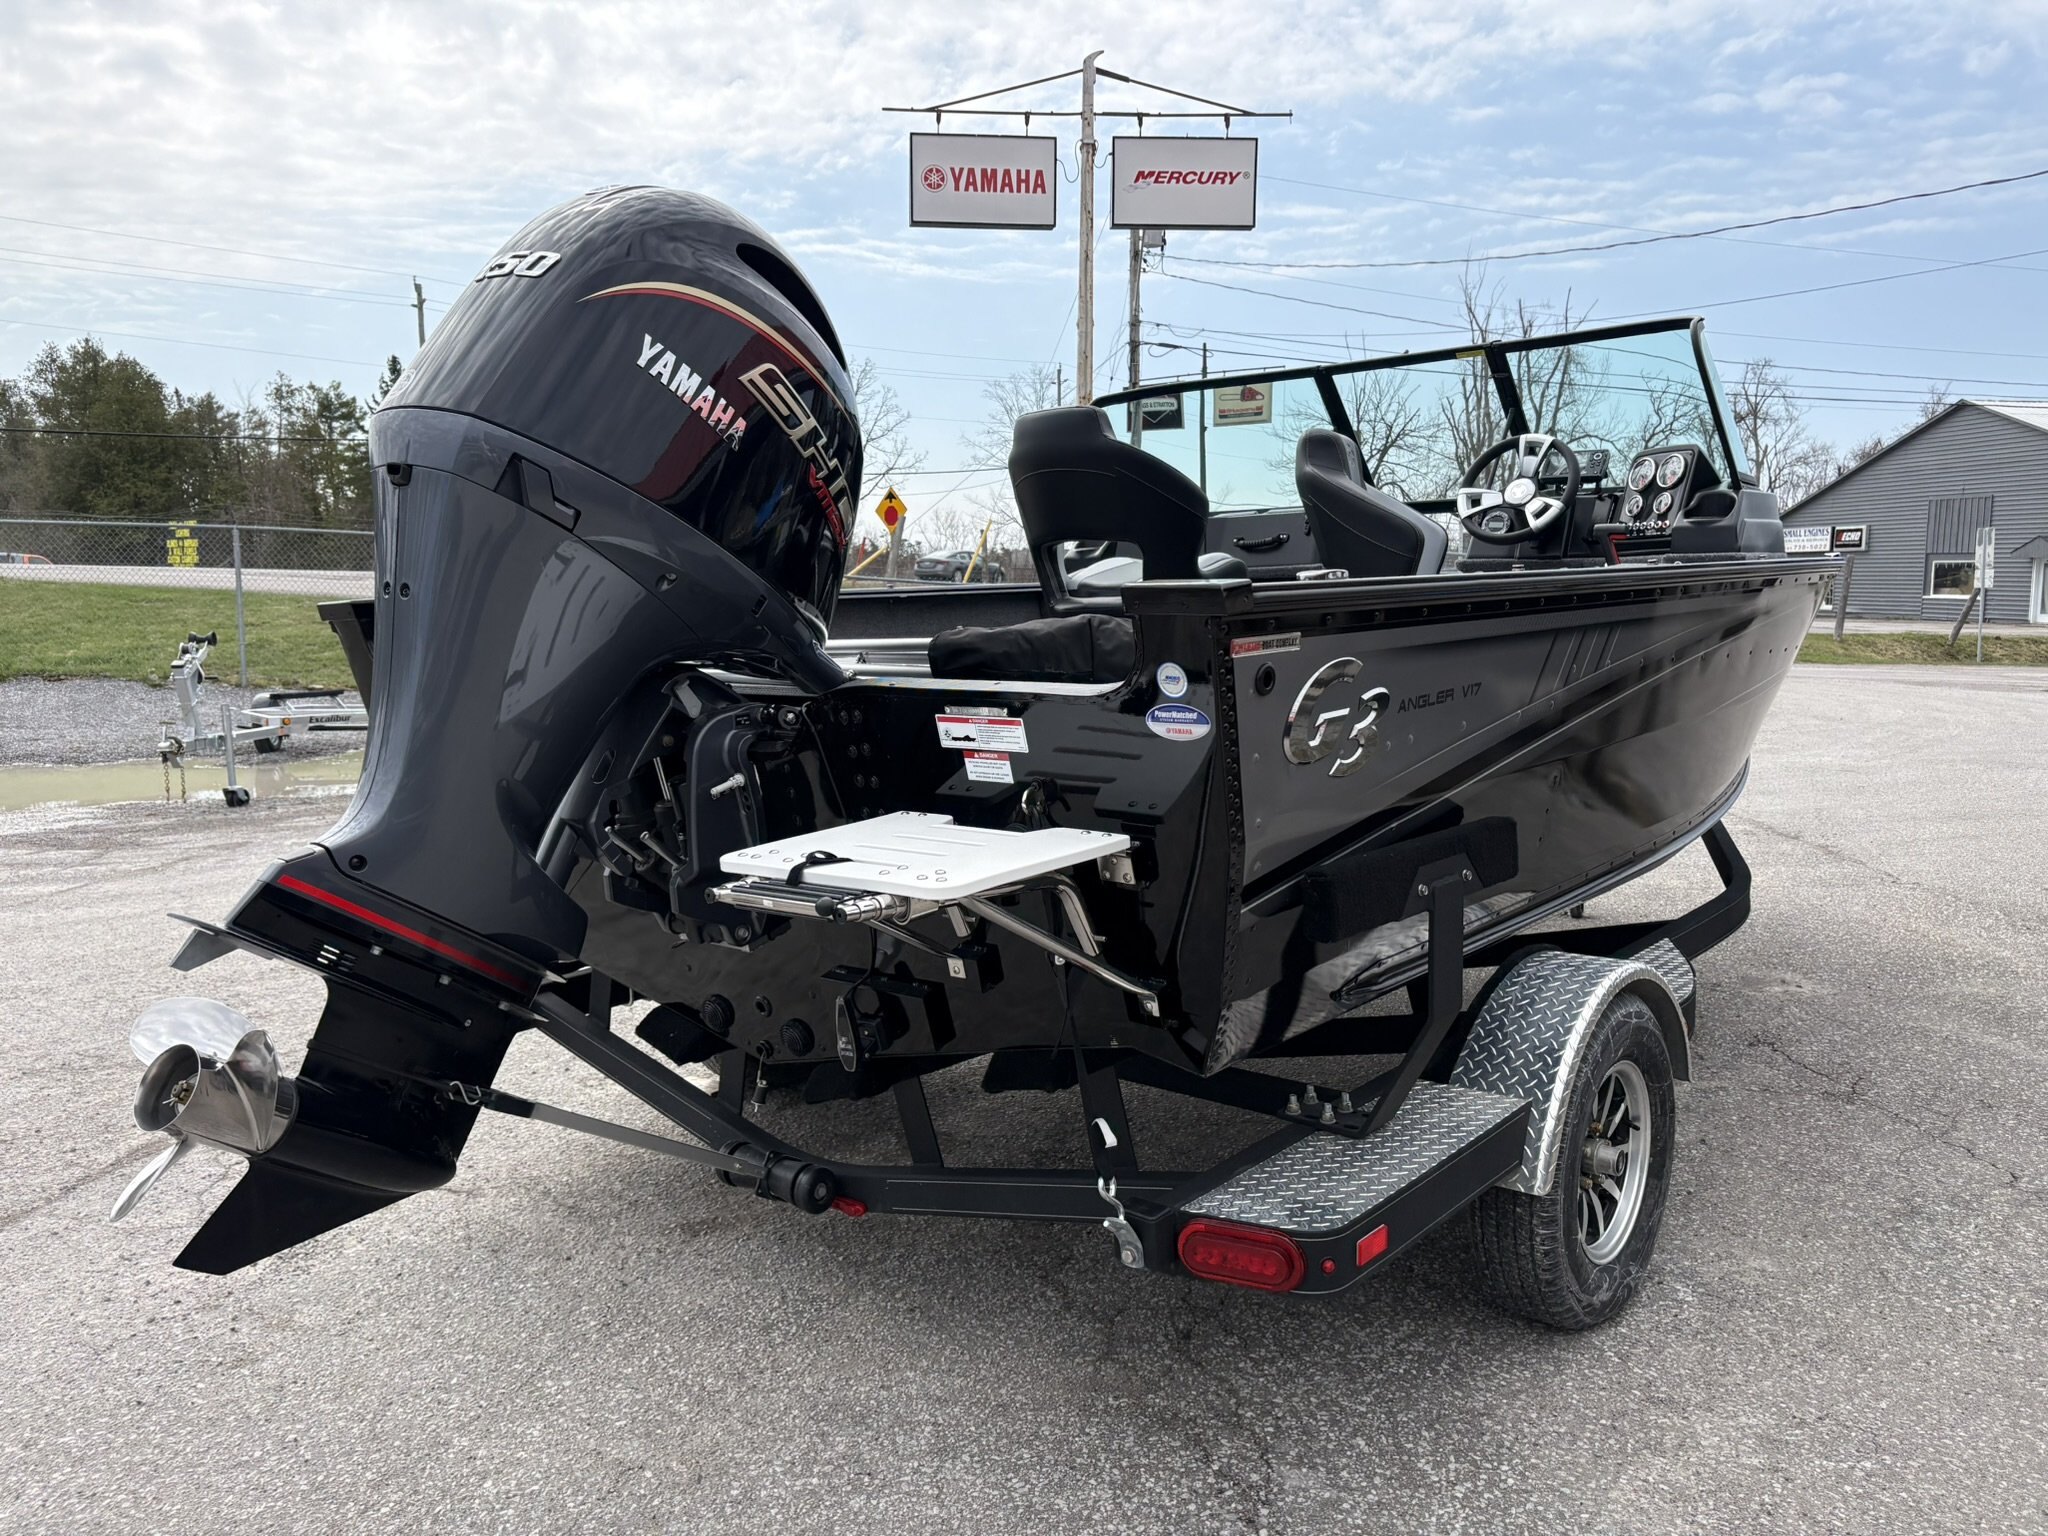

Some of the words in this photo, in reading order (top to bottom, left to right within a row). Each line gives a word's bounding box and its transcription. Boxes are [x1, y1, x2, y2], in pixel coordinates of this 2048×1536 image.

[949, 166, 1047, 194] YAMAHA
[1133, 169, 1242, 186] MERCURY
[635, 333, 748, 453] YAMAHA
[1784, 529, 1803, 538] SMALL
[1804, 528, 1830, 537] ENGINES
[1842, 531, 1862, 541] ECHO
[1397, 687, 1455, 714] ANGLER
[1461, 681, 1483, 698] V17
[309, 714, 352, 724] Excalibur
[1154, 709, 1198, 719] PowerMatched
[1170, 727, 1193, 735] YAMAHA
